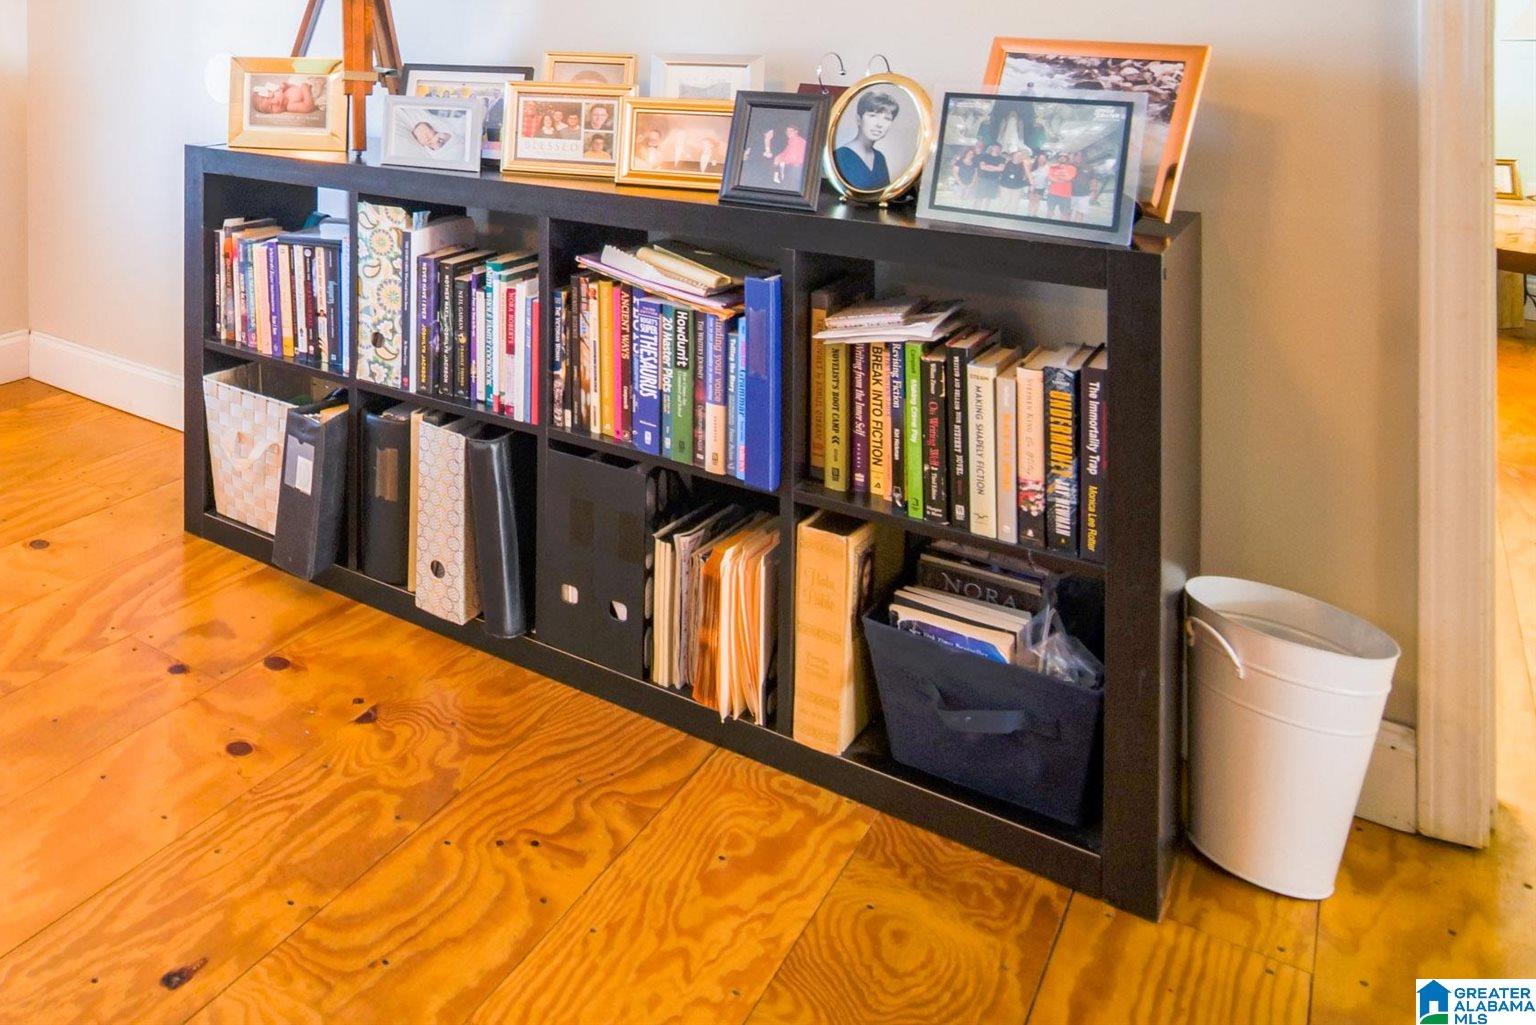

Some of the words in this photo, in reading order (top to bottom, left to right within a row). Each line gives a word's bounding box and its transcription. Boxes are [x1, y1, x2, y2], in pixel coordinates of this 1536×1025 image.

[523, 139, 580, 153] BLESSED
[507, 292, 515, 313] NORA
[621, 291, 630, 332] ANCIENT
[507, 314, 515, 344] ROBERTS
[663, 317, 673, 330] 20
[622, 334, 630, 360] WAYS
[663, 331, 673, 367] Master
[677, 311, 688, 368] Howdunit
[640, 334, 659, 400] THESAURUS
[714, 355, 722, 375] your
[832, 348, 841, 389] NOVELIST'S
[853, 343, 865, 369] Writing
[872, 346, 883, 386] BREAK
[892, 343, 902, 378] Revising
[663, 368, 673, 392] Plots
[715, 378, 723, 402] voice
[854, 370, 865, 388] from
[1089, 382, 1100, 398] The
[739, 369, 747, 417] Grammar
[832, 392, 841, 412] BOOT
[856, 389, 865, 401] the
[872, 389, 883, 417] INTO
[893, 380, 902, 408] Fiction
[975, 385, 983, 420] MAKING
[856, 401, 865, 421] Inner
[930, 401, 939, 415] On
[832, 413, 841, 433] CAMP
[855, 422, 866, 437] Self
[928, 417, 940, 447] Writing
[1050, 390, 1073, 479] UNDERMONEY
[1087, 400, 1100, 453] Immortality
[872, 420, 883, 467] FICTION
[911, 429, 919, 444] Pay
[976, 423, 984, 458] SHAPELY
[929, 448, 940, 467] Well
[1087, 454, 1100, 476] Trap
[977, 460, 986, 495] FICTION
[1055, 478, 1070, 496] JAY
[1088, 485, 1097, 512] Monica
[1056, 497, 1071, 537] NEWMAN
[1088, 513, 1097, 527] Lee
[1088, 528, 1097, 552] Rotter
[941, 572, 1017, 607] NORA
